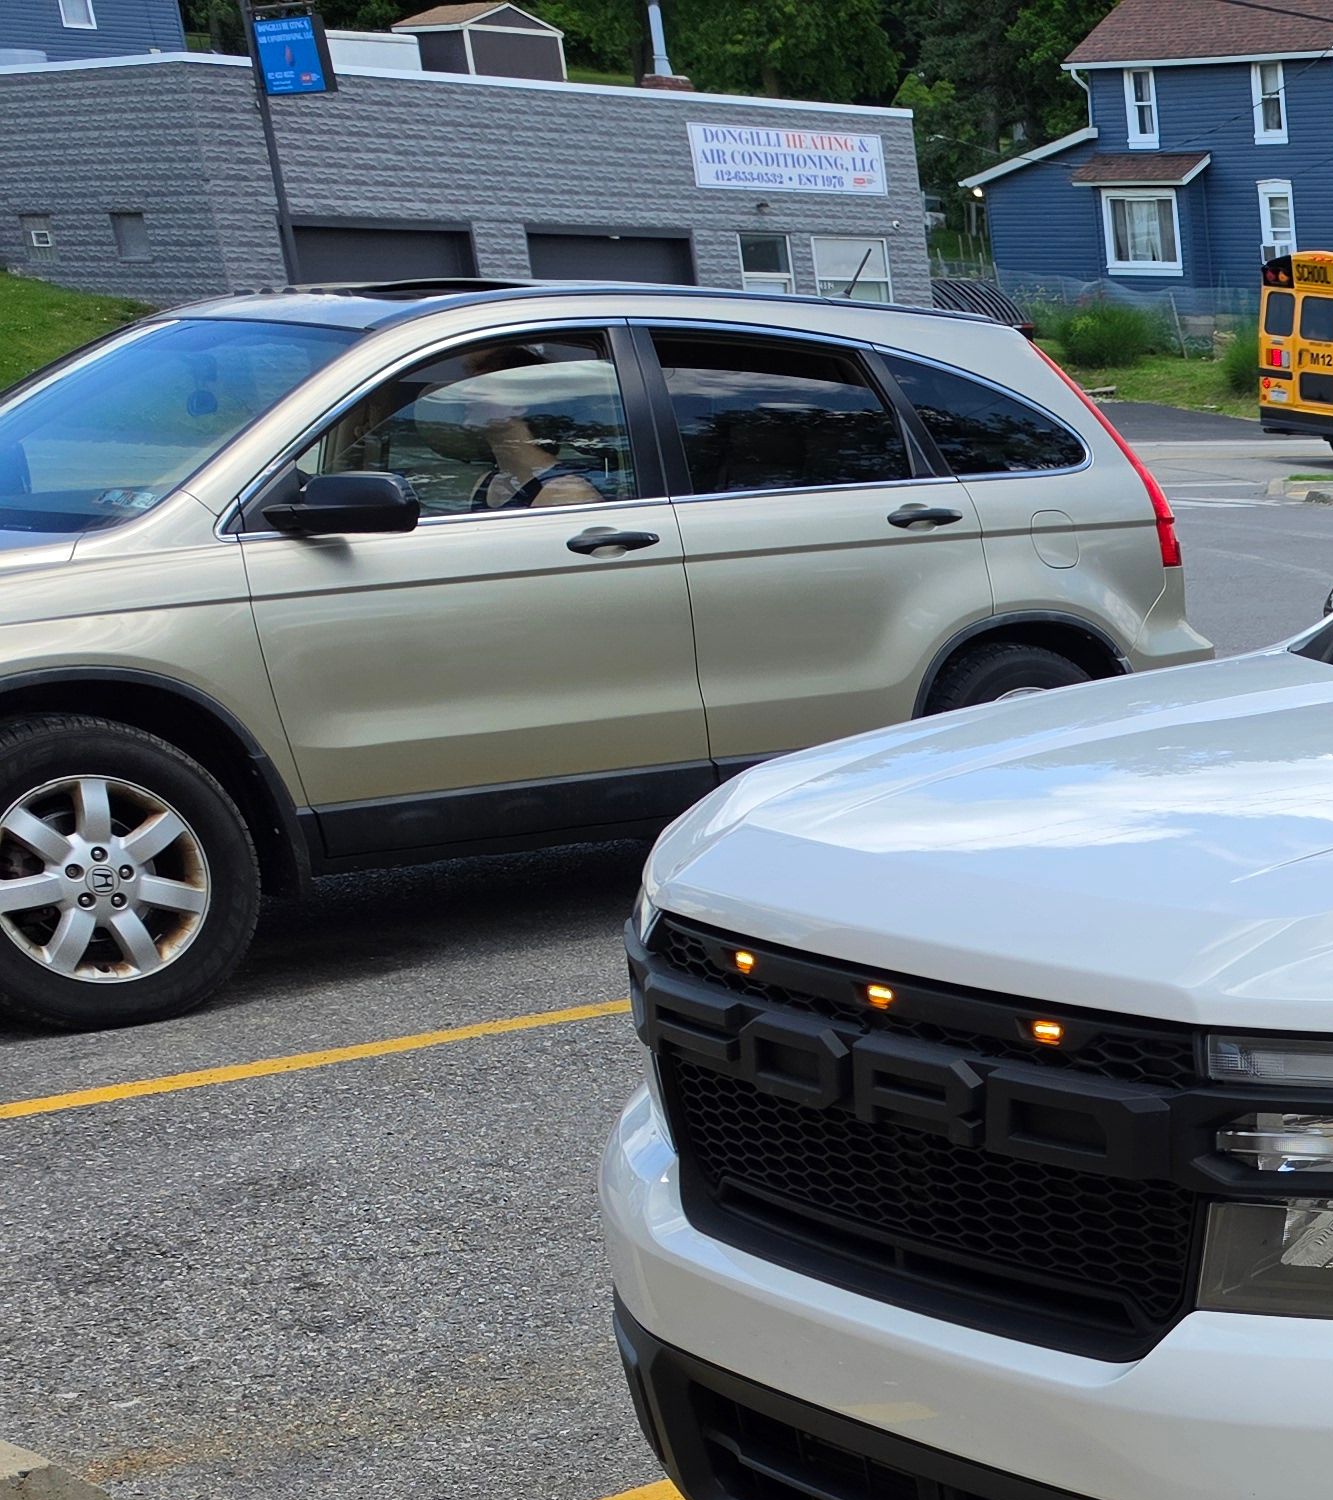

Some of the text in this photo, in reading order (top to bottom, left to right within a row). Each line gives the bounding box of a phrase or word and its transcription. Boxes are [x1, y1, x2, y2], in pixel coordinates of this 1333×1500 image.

[702, 127, 869, 153] DONGILLI HEATING &
[700, 148, 879, 173] AIR CONDITIONING, LLC
[798, 173, 819, 187] EST
[821, 174, 845, 188] 1976
[1295, 263, 1331, 284] SCHOOL
[1310, 351, 1333, 367] M12
[644, 972, 1173, 1180] FORD
